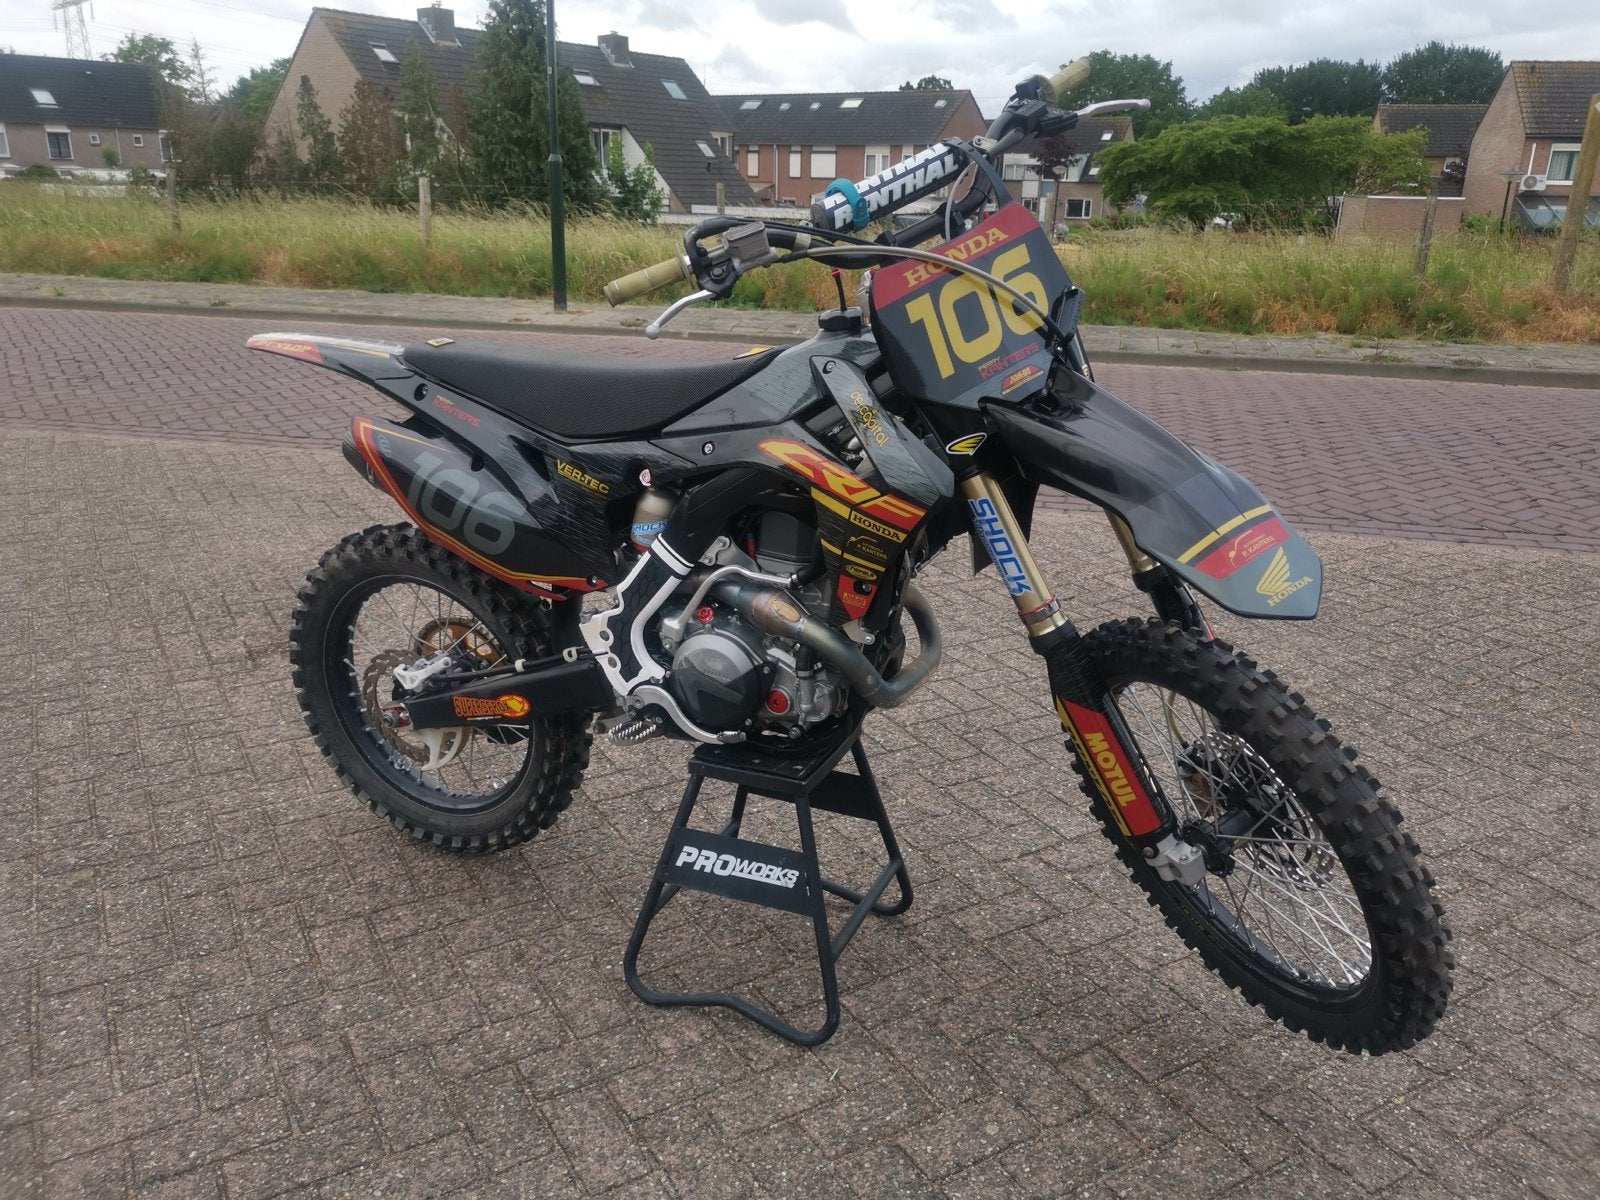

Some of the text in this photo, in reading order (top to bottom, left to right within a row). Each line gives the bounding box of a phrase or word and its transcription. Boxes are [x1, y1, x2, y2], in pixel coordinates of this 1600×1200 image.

[834, 154, 960, 230] RNTHAL
[902, 227, 1009, 288] HONDA
[905, 243, 1049, 379] 106
[407, 451, 524, 556] 106
[853, 512, 902, 541] HONDA
[967, 497, 1033, 595] SHOCK
[1267, 576, 1314, 607] HONDA
[1084, 732, 1137, 807] MOTUL
